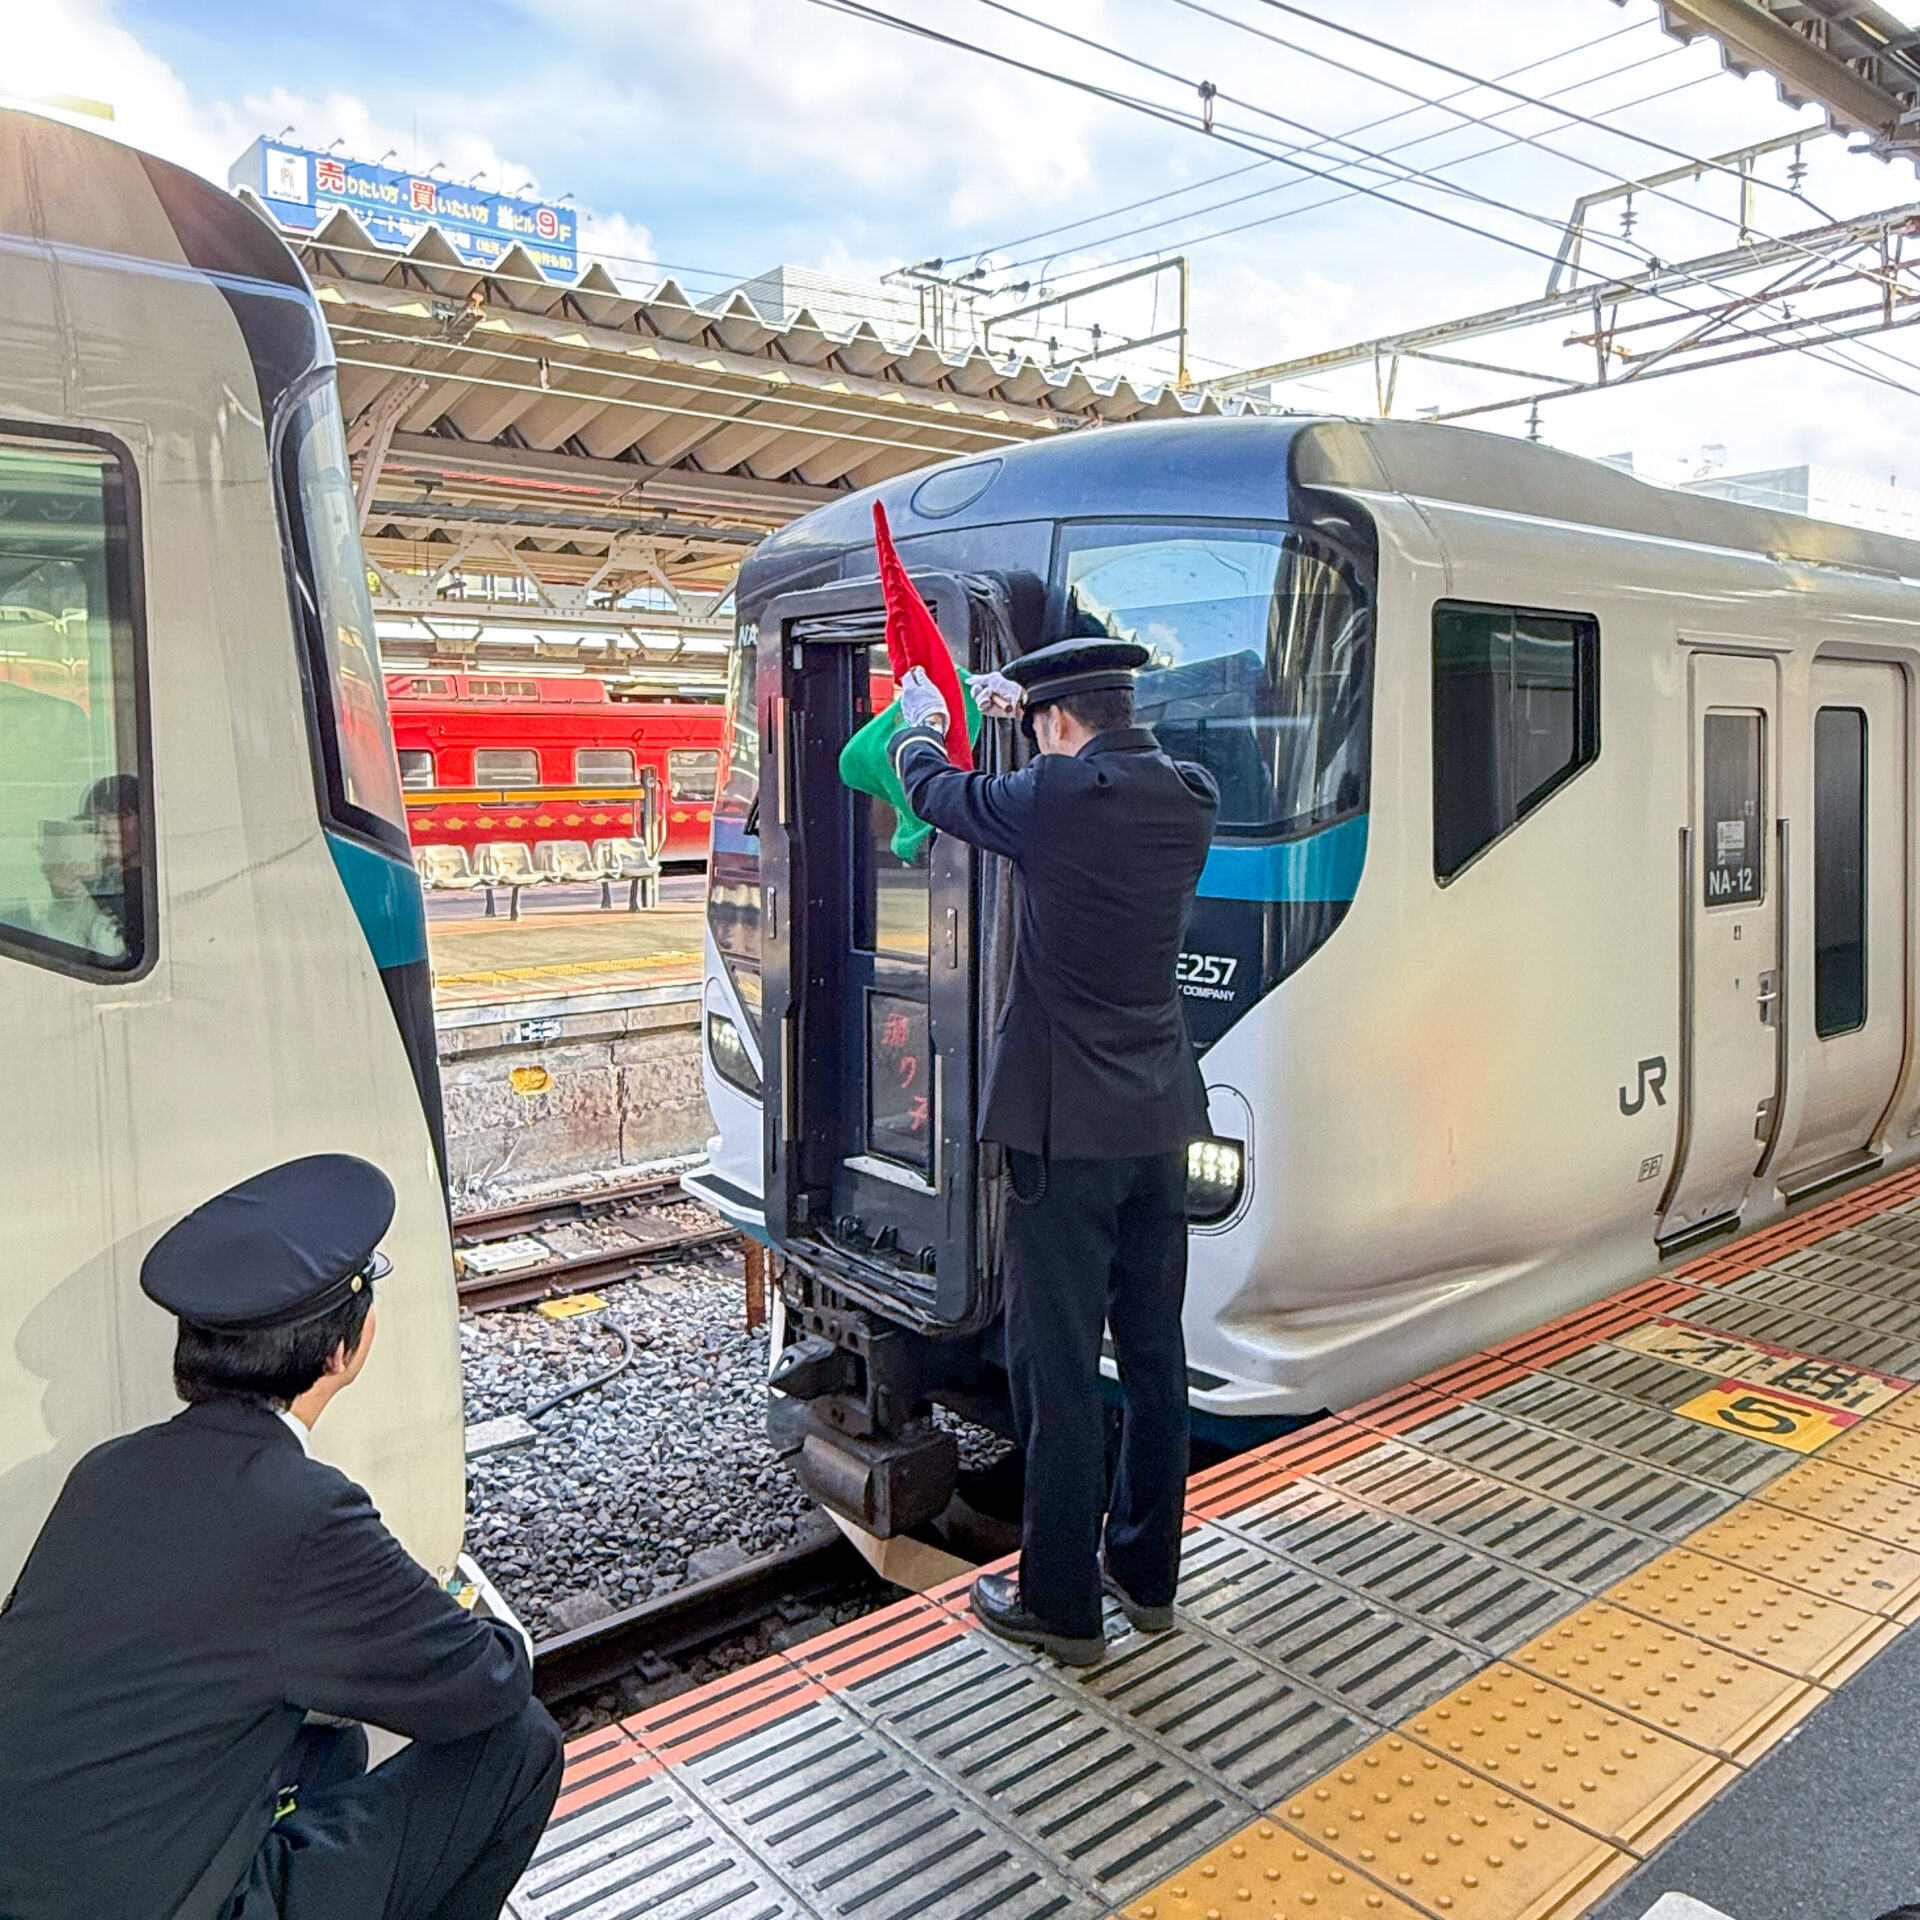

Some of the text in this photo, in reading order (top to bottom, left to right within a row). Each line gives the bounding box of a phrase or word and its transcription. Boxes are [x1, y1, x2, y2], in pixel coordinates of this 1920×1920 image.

[1709, 867, 1753, 896] NA-12
[1175, 953, 1238, 986] E257
[1183, 985, 1236, 1002] COMPANY
[1619, 1055, 1667, 1117] JR
[1717, 1396, 1812, 1435] 5
